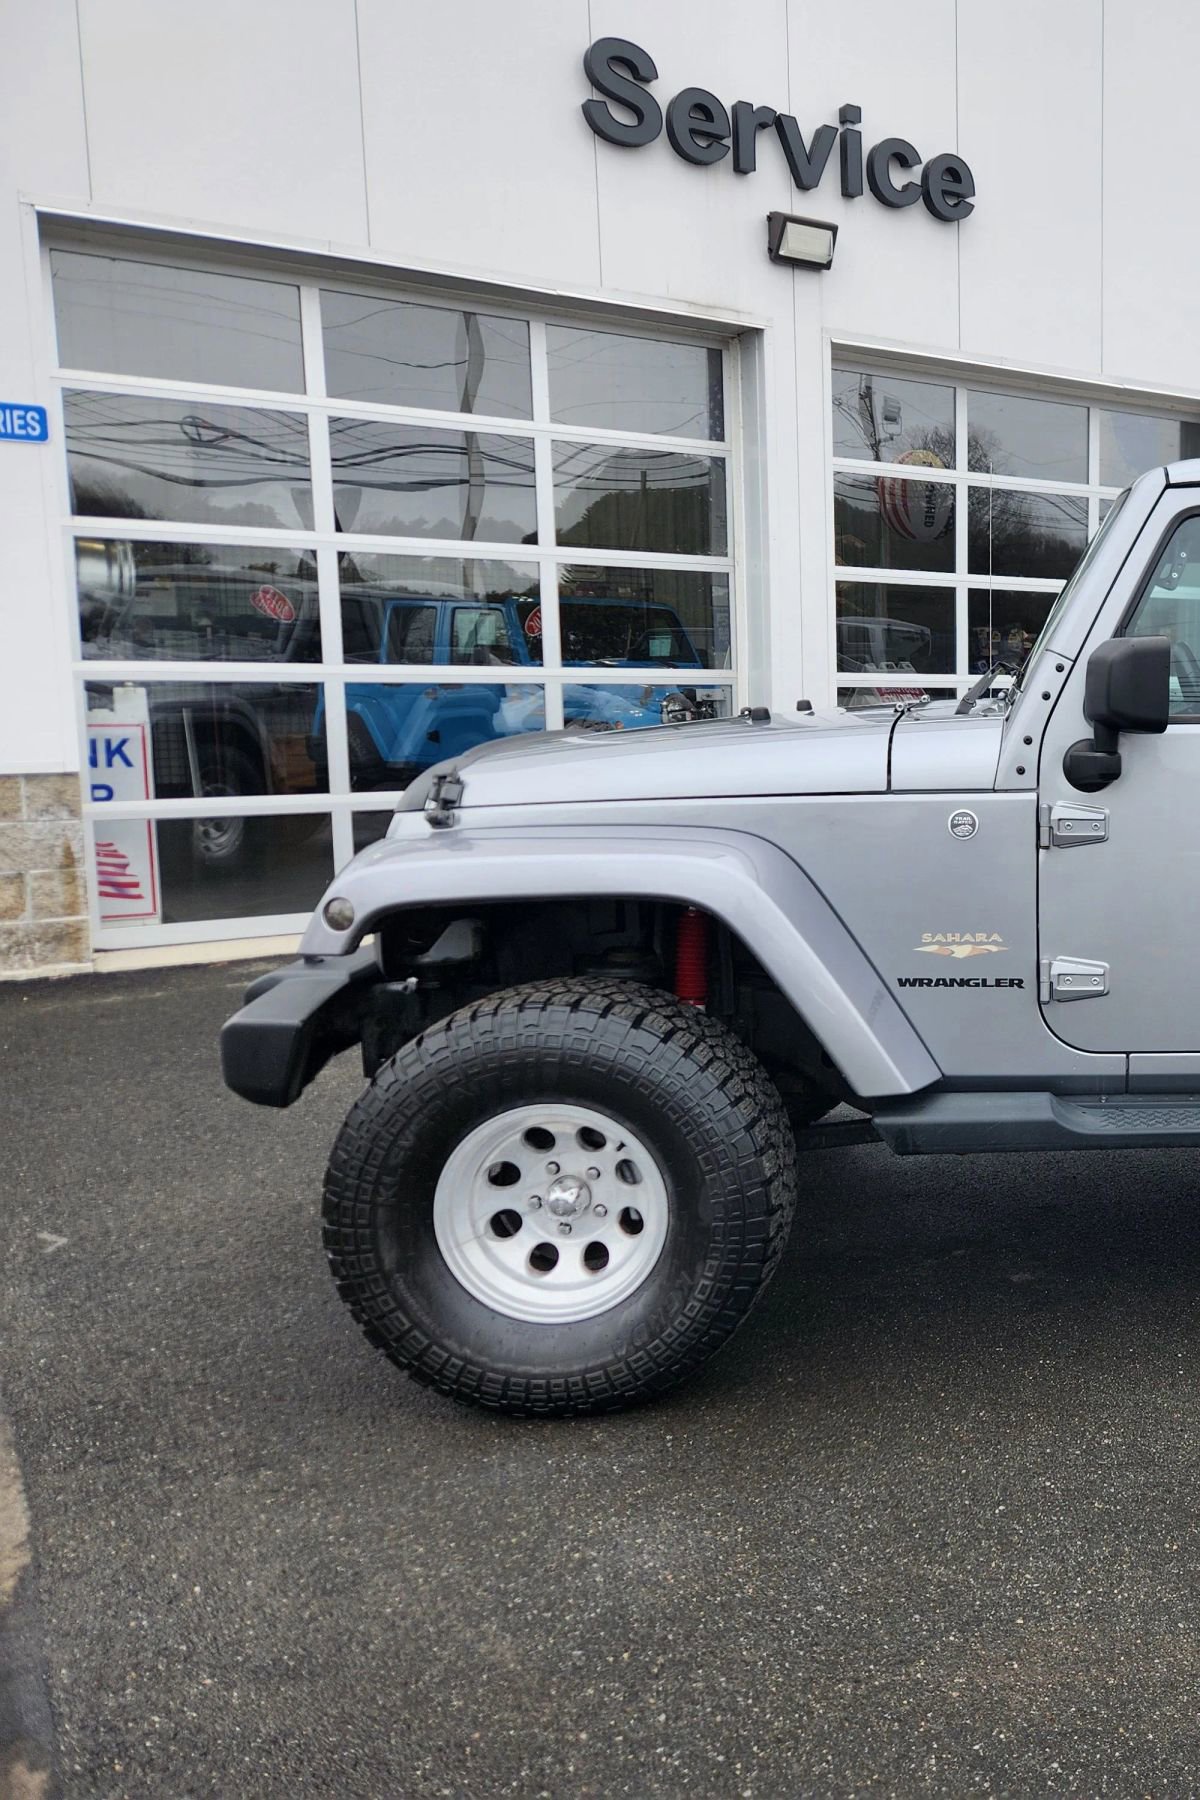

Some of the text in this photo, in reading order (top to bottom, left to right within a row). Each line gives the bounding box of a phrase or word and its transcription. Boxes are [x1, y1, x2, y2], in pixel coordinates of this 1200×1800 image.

[581, 36, 976, 222] Service
[921, 932, 1004, 943] SAHARA
[897, 977, 1025, 989] WRANGLER
